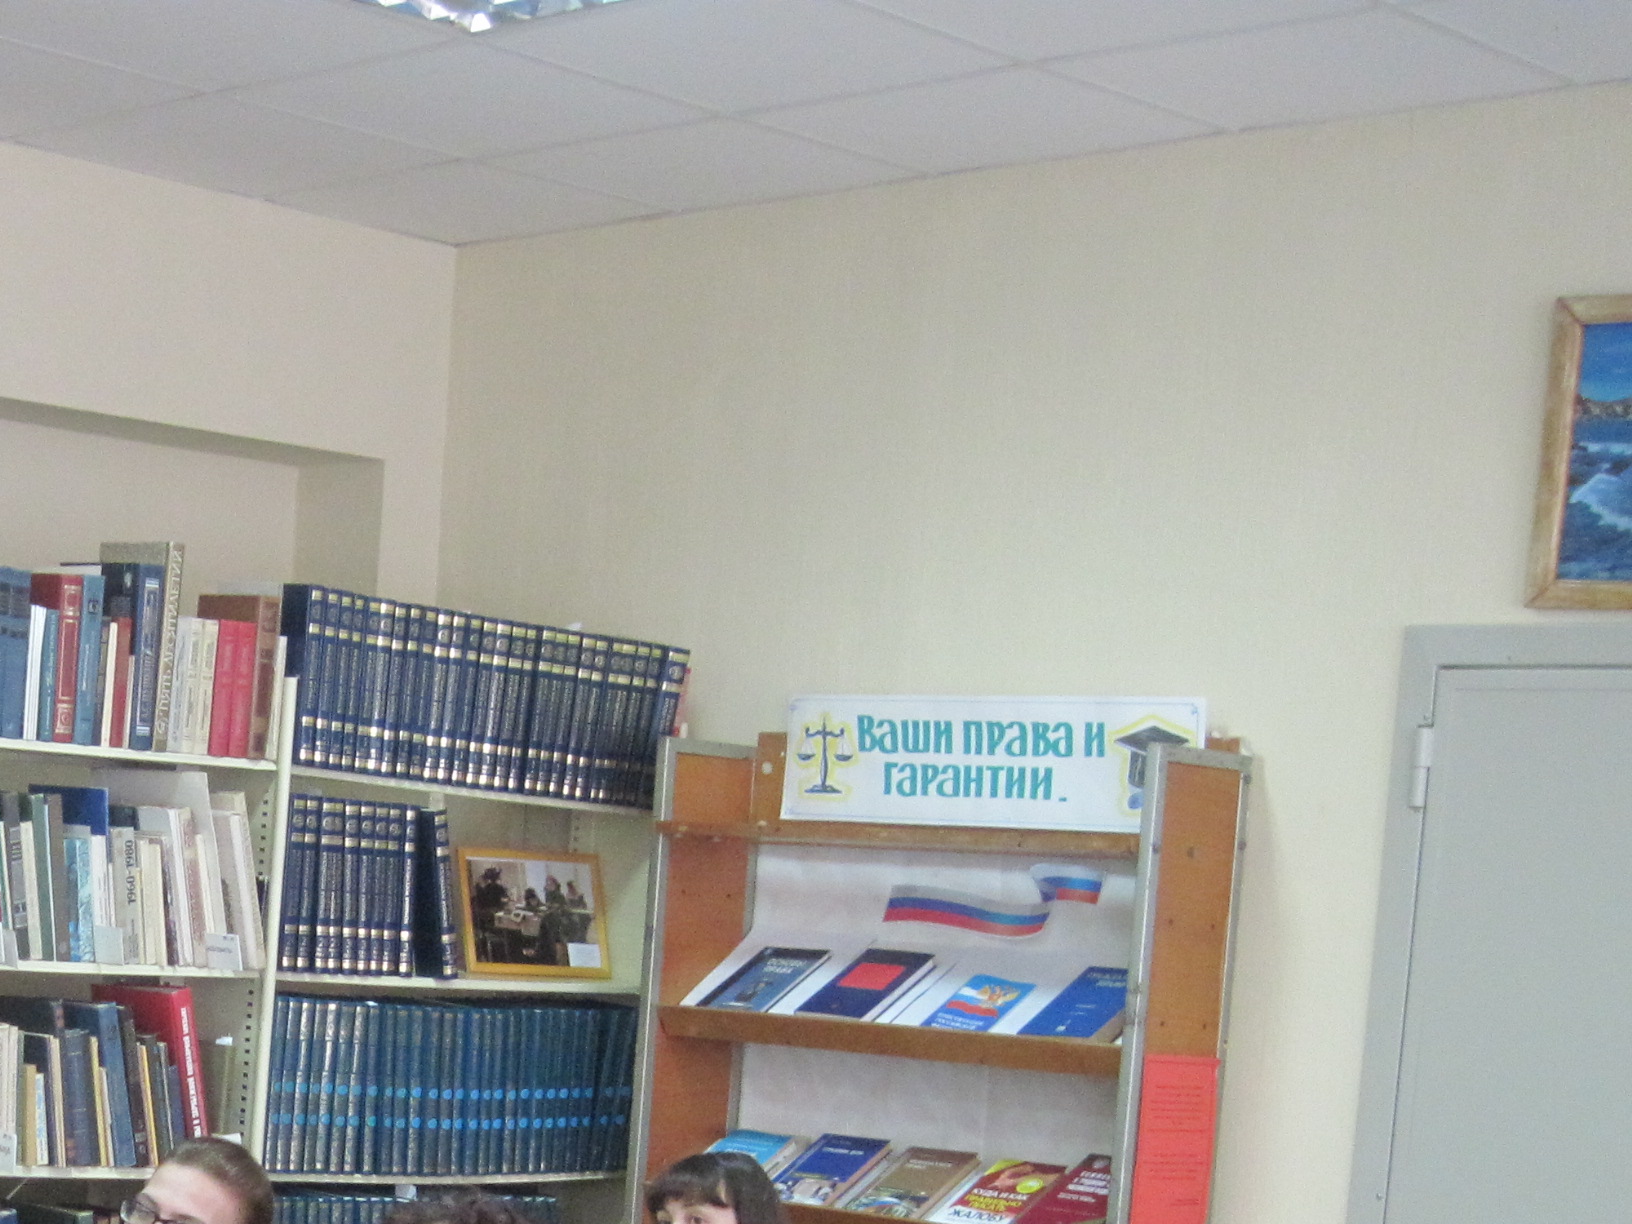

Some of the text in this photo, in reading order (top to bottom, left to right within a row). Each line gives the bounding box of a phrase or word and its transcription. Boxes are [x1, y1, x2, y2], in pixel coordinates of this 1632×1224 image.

[856, 714, 954, 754] Ваши
[963, 720, 1075, 757] права
[948, 1208, 1006, 1222] ЖАЛОБУ
